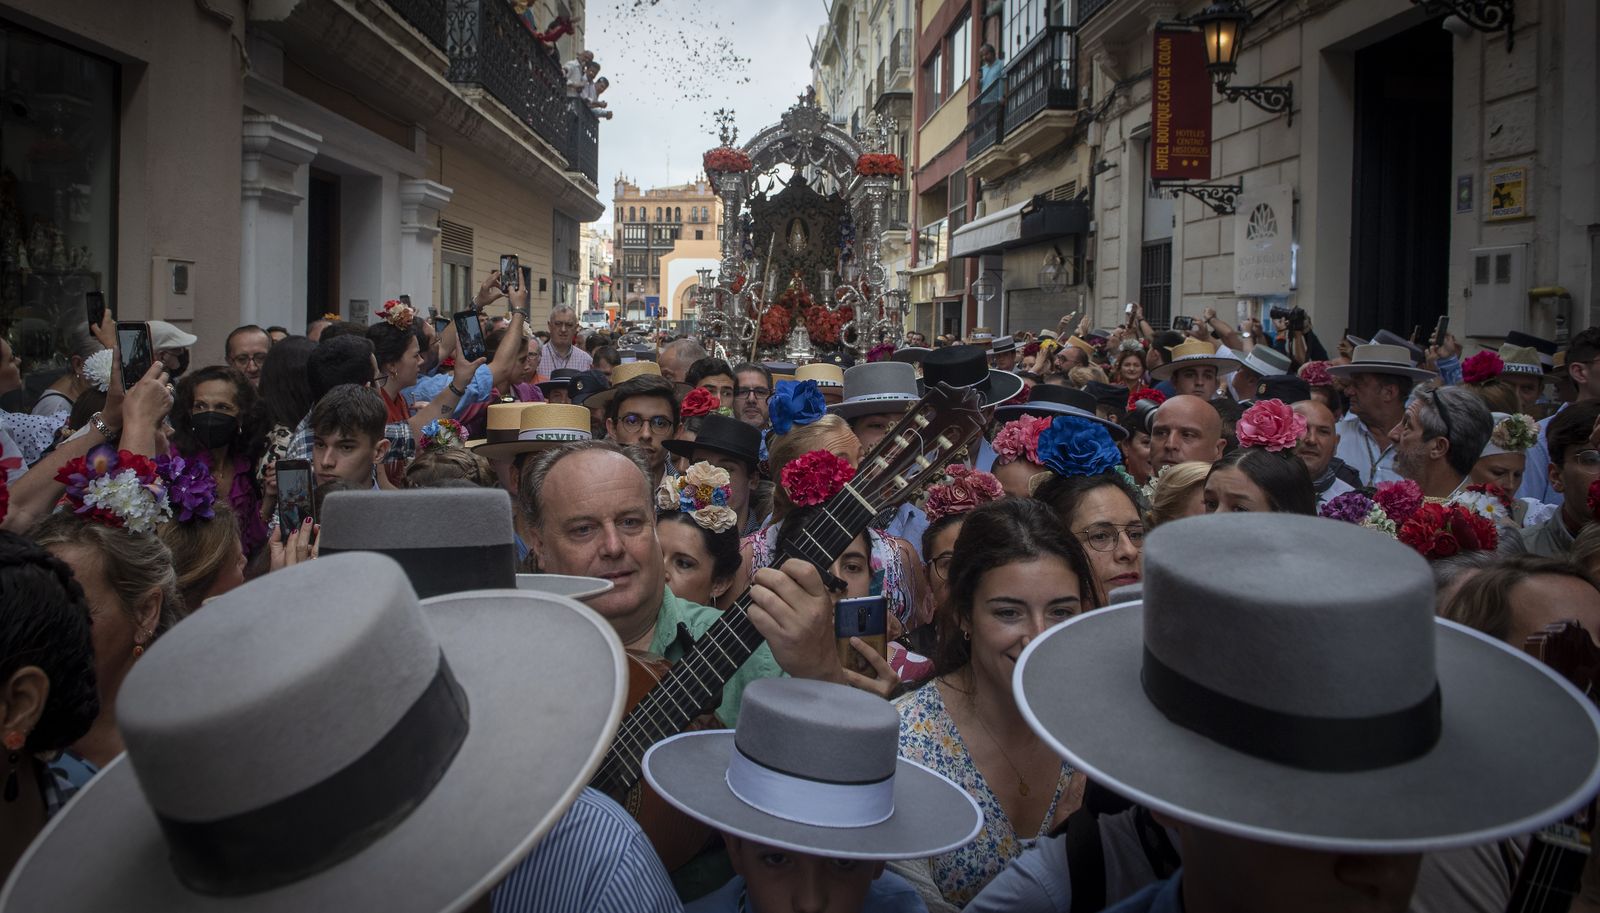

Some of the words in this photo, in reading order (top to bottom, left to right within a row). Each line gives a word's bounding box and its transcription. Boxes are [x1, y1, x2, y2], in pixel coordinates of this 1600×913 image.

[1158, 67, 1170, 77] DE
[1158, 80, 1170, 101] CASA
[1157, 103, 1172, 144] BOUTIQUE
[1176, 129, 1205, 137] HOTELES
[1176, 137, 1204, 145] CENTRO
[1156, 145, 1169, 170] HOTEL
